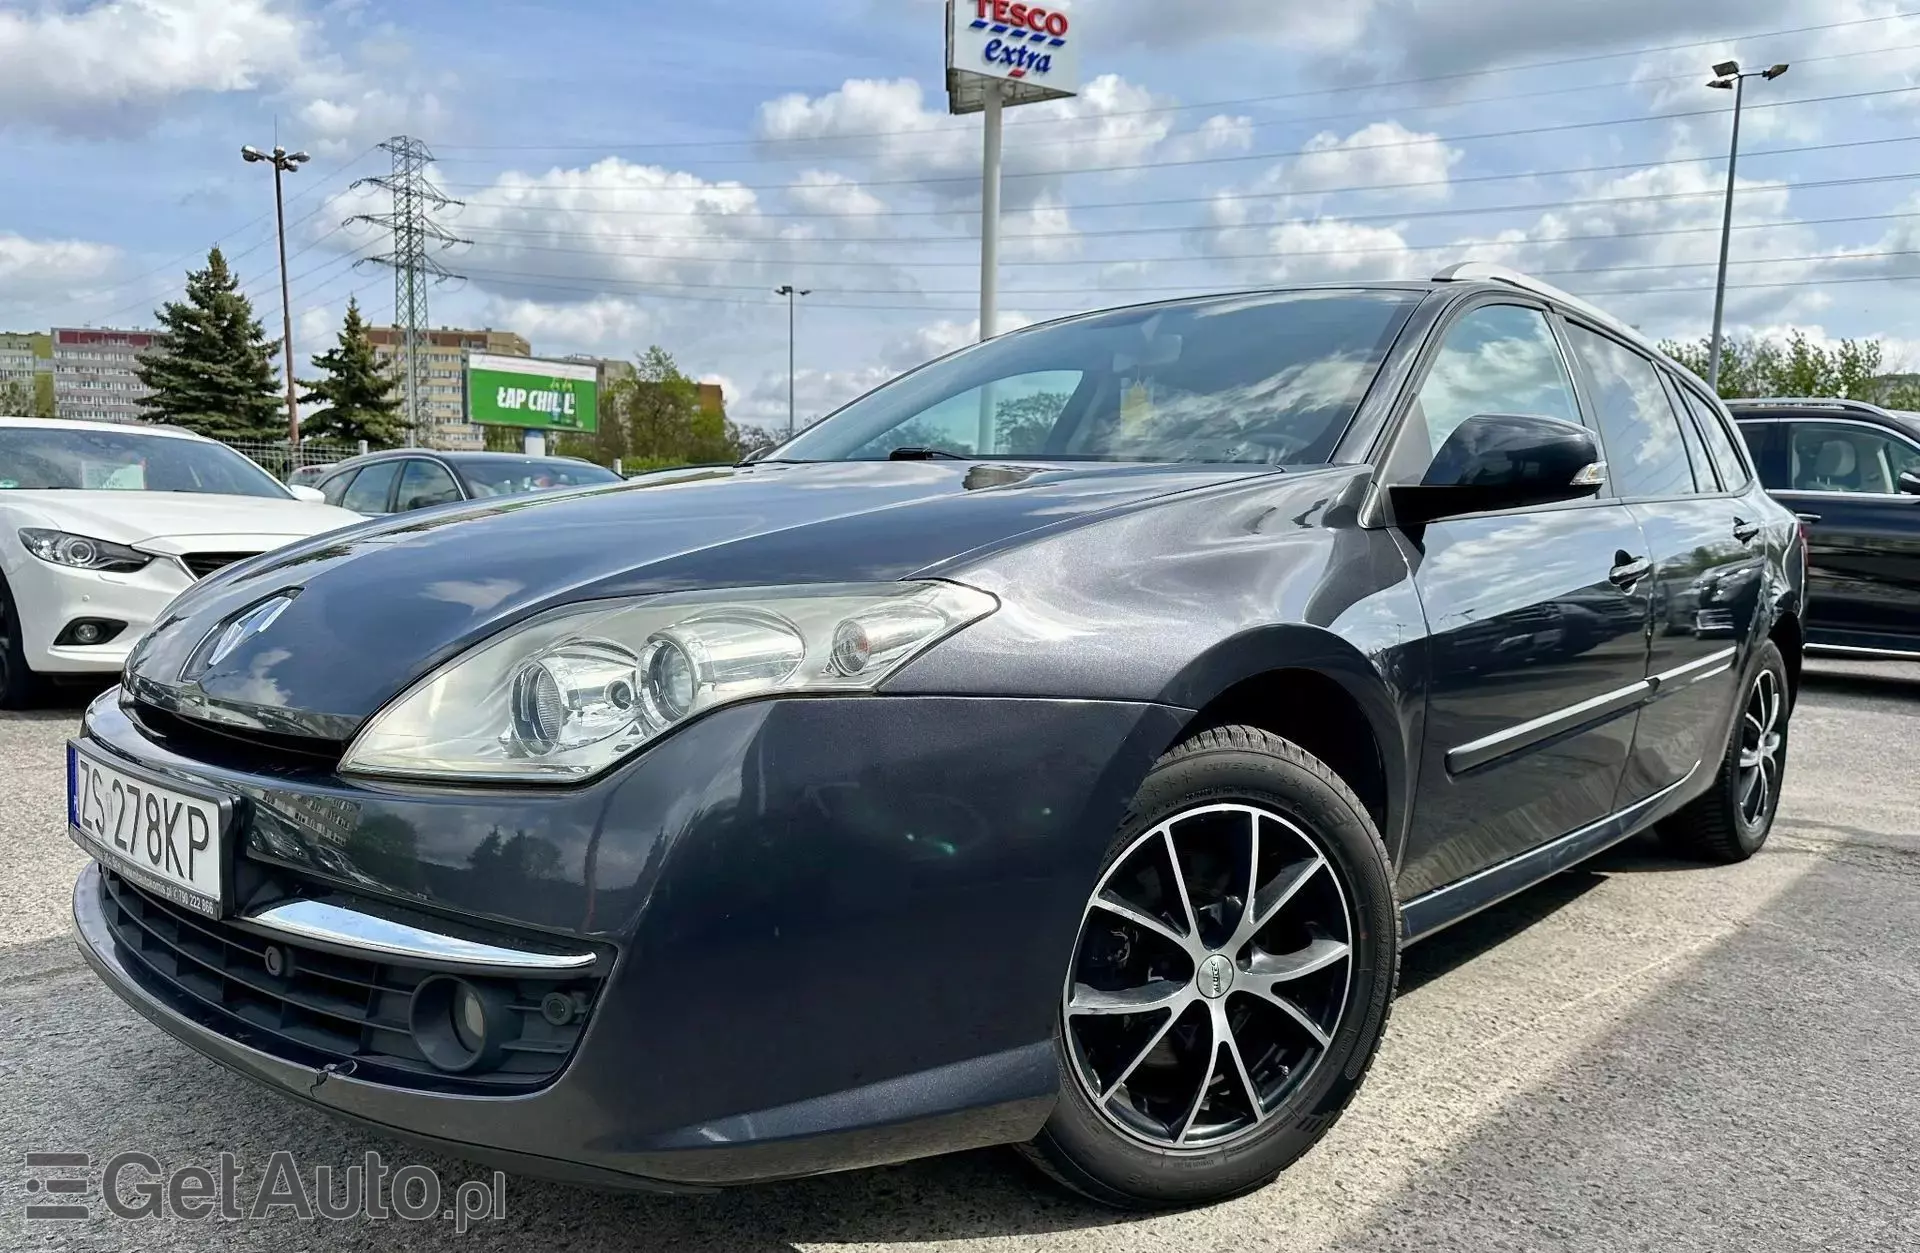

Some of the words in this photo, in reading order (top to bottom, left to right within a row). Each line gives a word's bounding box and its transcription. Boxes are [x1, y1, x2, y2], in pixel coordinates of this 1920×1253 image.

[972, 0, 1068, 36] TESCO
[984, 38, 1053, 73] extra
[496, 386, 527, 410] ŁAP
[80, 759, 106, 836] ZS
[112, 778, 210, 882] 278KP
